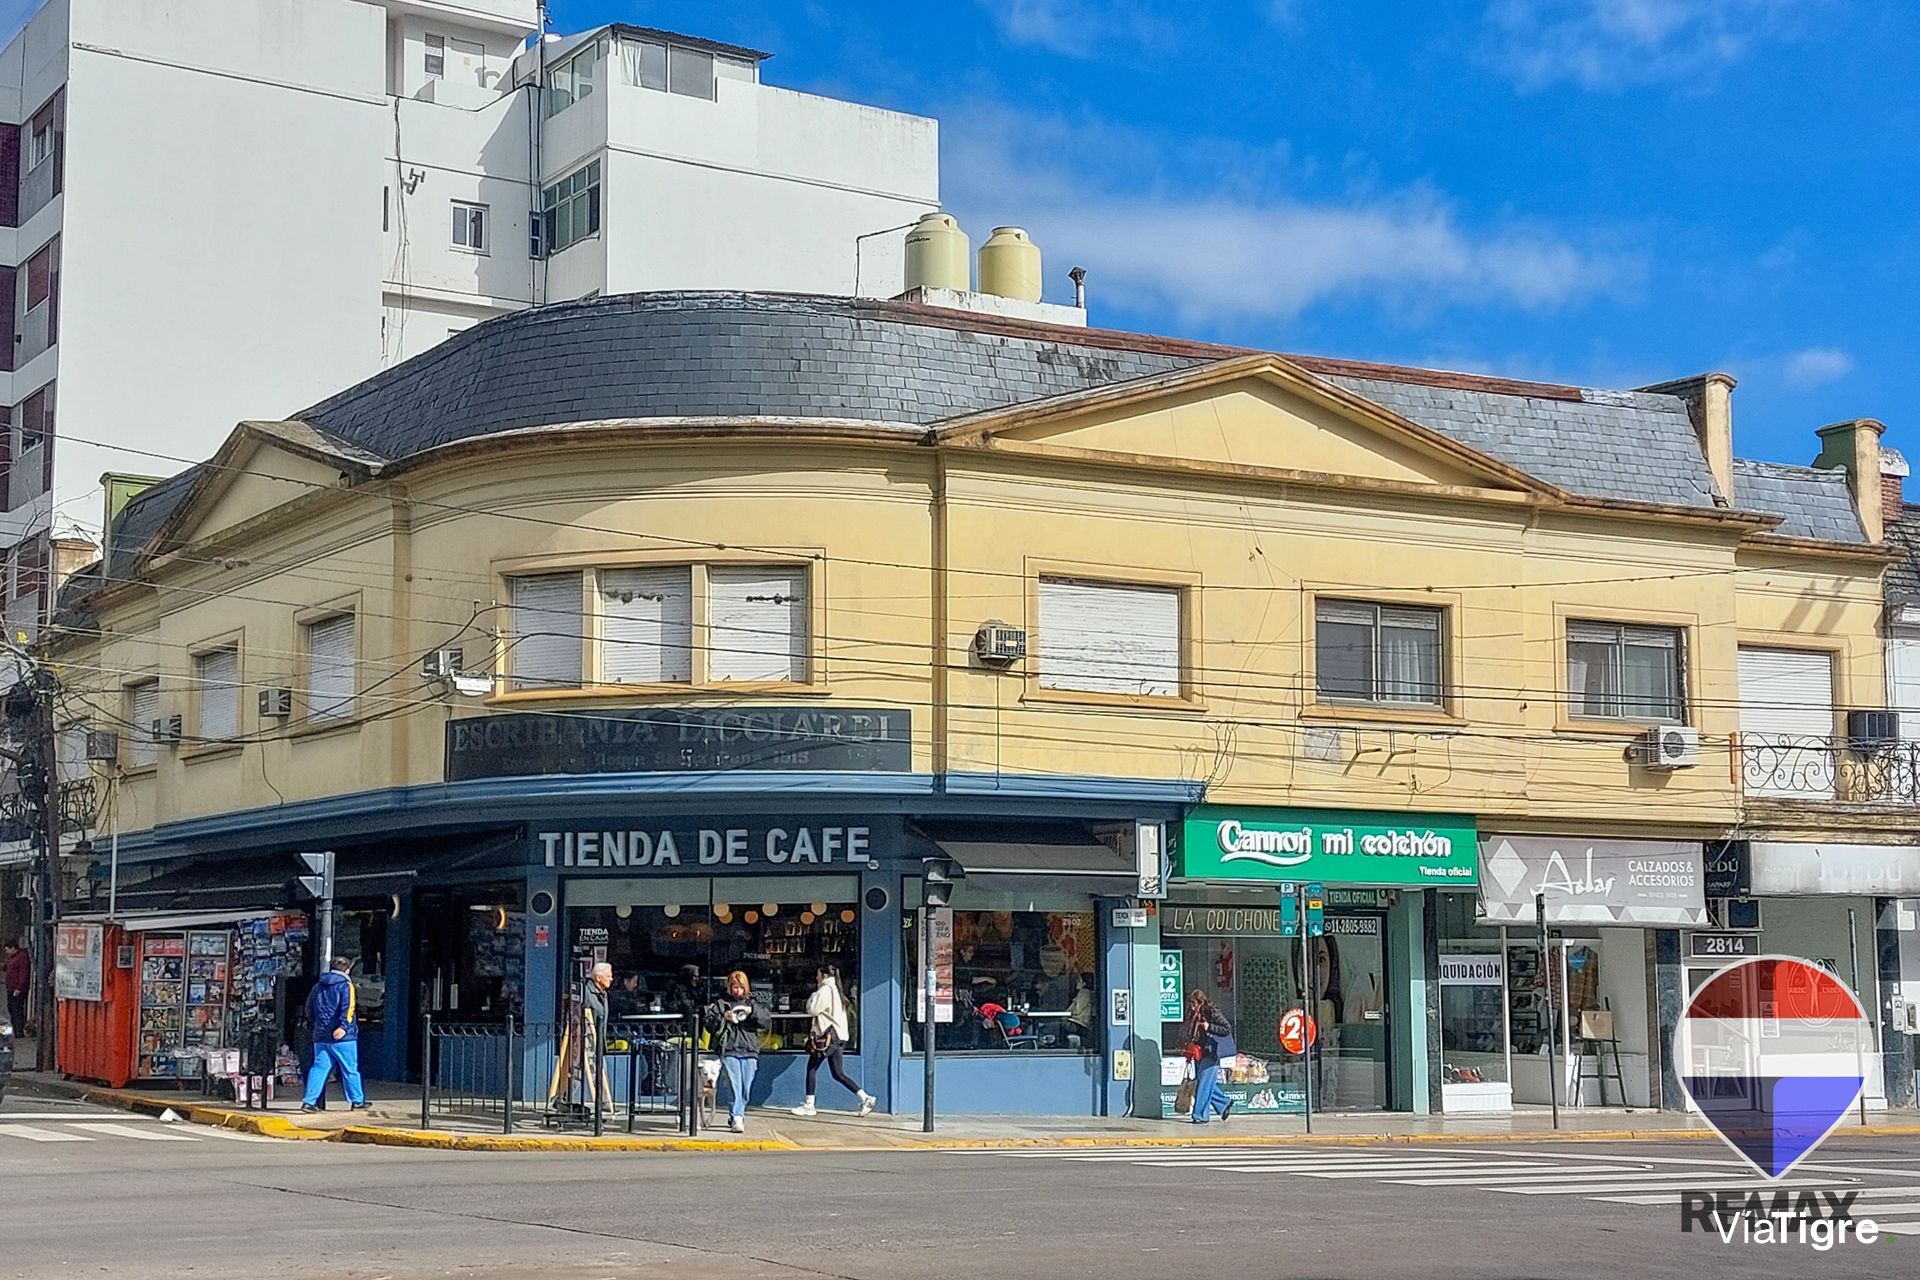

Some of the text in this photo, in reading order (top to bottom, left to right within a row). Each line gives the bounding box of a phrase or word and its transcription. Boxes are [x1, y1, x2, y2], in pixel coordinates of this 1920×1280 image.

[539, 827, 870, 868] TIENDA DE CAFE
[1322, 829, 1354, 856] mi
[1360, 830, 1452, 858] colchón
[1420, 866, 1472, 877] Tienda oficial
[1628, 860, 1694, 873] CALZADOS &
[1628, 874, 1695, 887] ACCESORIOS
[1174, 909, 1195, 930] LA
[579, 928, 609, 936] TIENDA
[1706, 937, 1745, 953] 2814
[1439, 961, 1501, 979] IQUIDACIÓN
